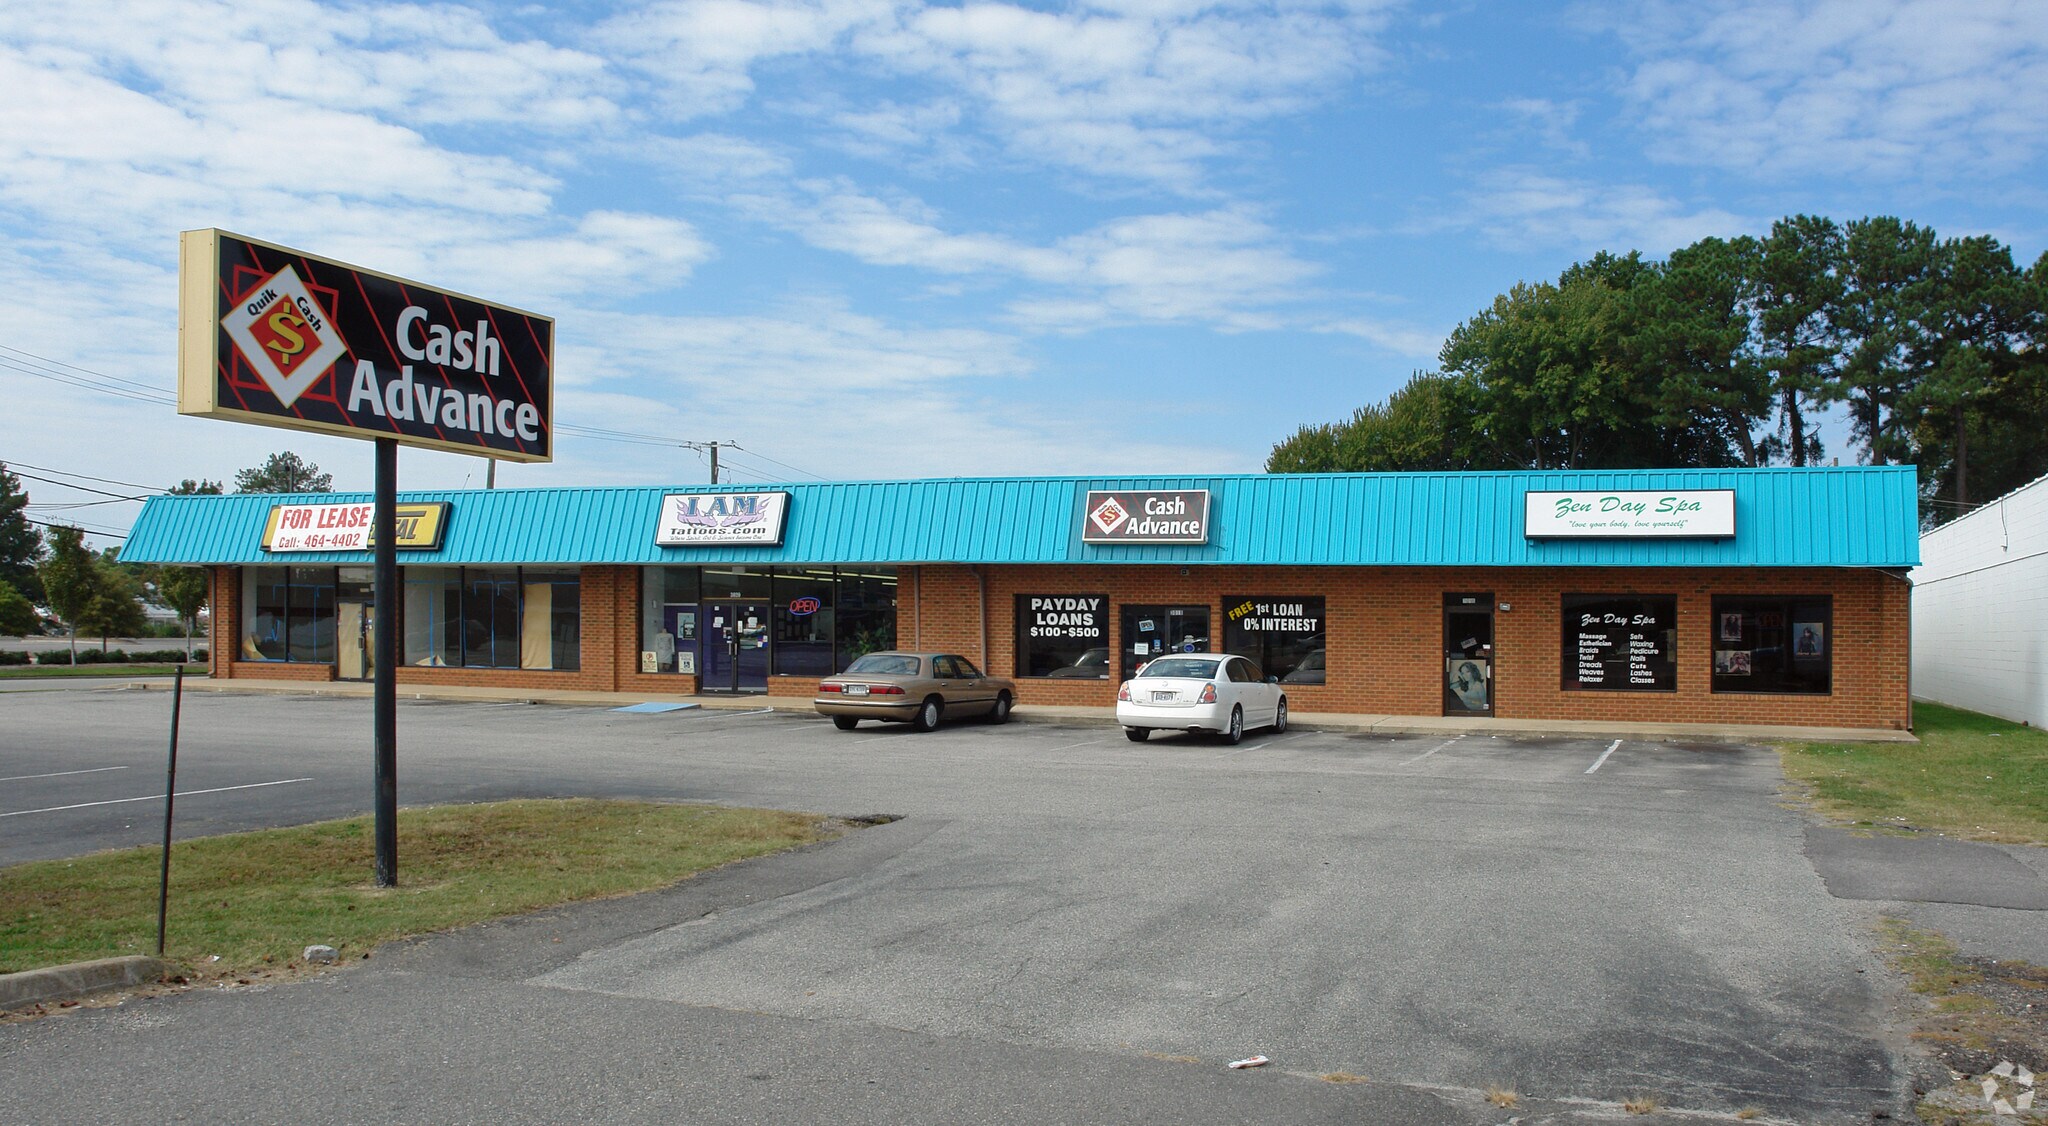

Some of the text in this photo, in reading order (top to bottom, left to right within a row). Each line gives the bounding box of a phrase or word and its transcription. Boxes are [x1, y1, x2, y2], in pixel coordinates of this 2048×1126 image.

[247, 289, 278, 316] Quik
[296, 296, 322, 332] Cash
[396, 305, 500, 377] Cash
[347, 358, 539, 442] Advance
[686, 495, 760, 517] I AM
[1144, 496, 1186, 515] Cash
[1555, 496, 1703, 519] Zen Day Spa
[280, 506, 371, 530] FOR LEASE
[1125, 516, 1200, 535] Advance
[1589, 521, 1607, 530] your
[1634, 519, 1650, 529] love
[670, 527, 767, 536] Tattoos.com
[278, 533, 361, 548] Call: 464-4402
[789, 599, 819, 613] OPEN
[1031, 598, 1101, 611] PAYDAY
[1228, 600, 1304, 621] FREE 1st LOAN
[1036, 613, 1094, 626] LOANS
[1243, 617, 1318, 632] 0% INTEREST
[1581, 613, 1656, 627] Zen Day Spa
[1030, 626, 1100, 638] $100-$500
[1578, 633, 1608, 641] Massage
[1578, 647, 1600, 655] Braids
[1629, 641, 1655, 649] Waxing
